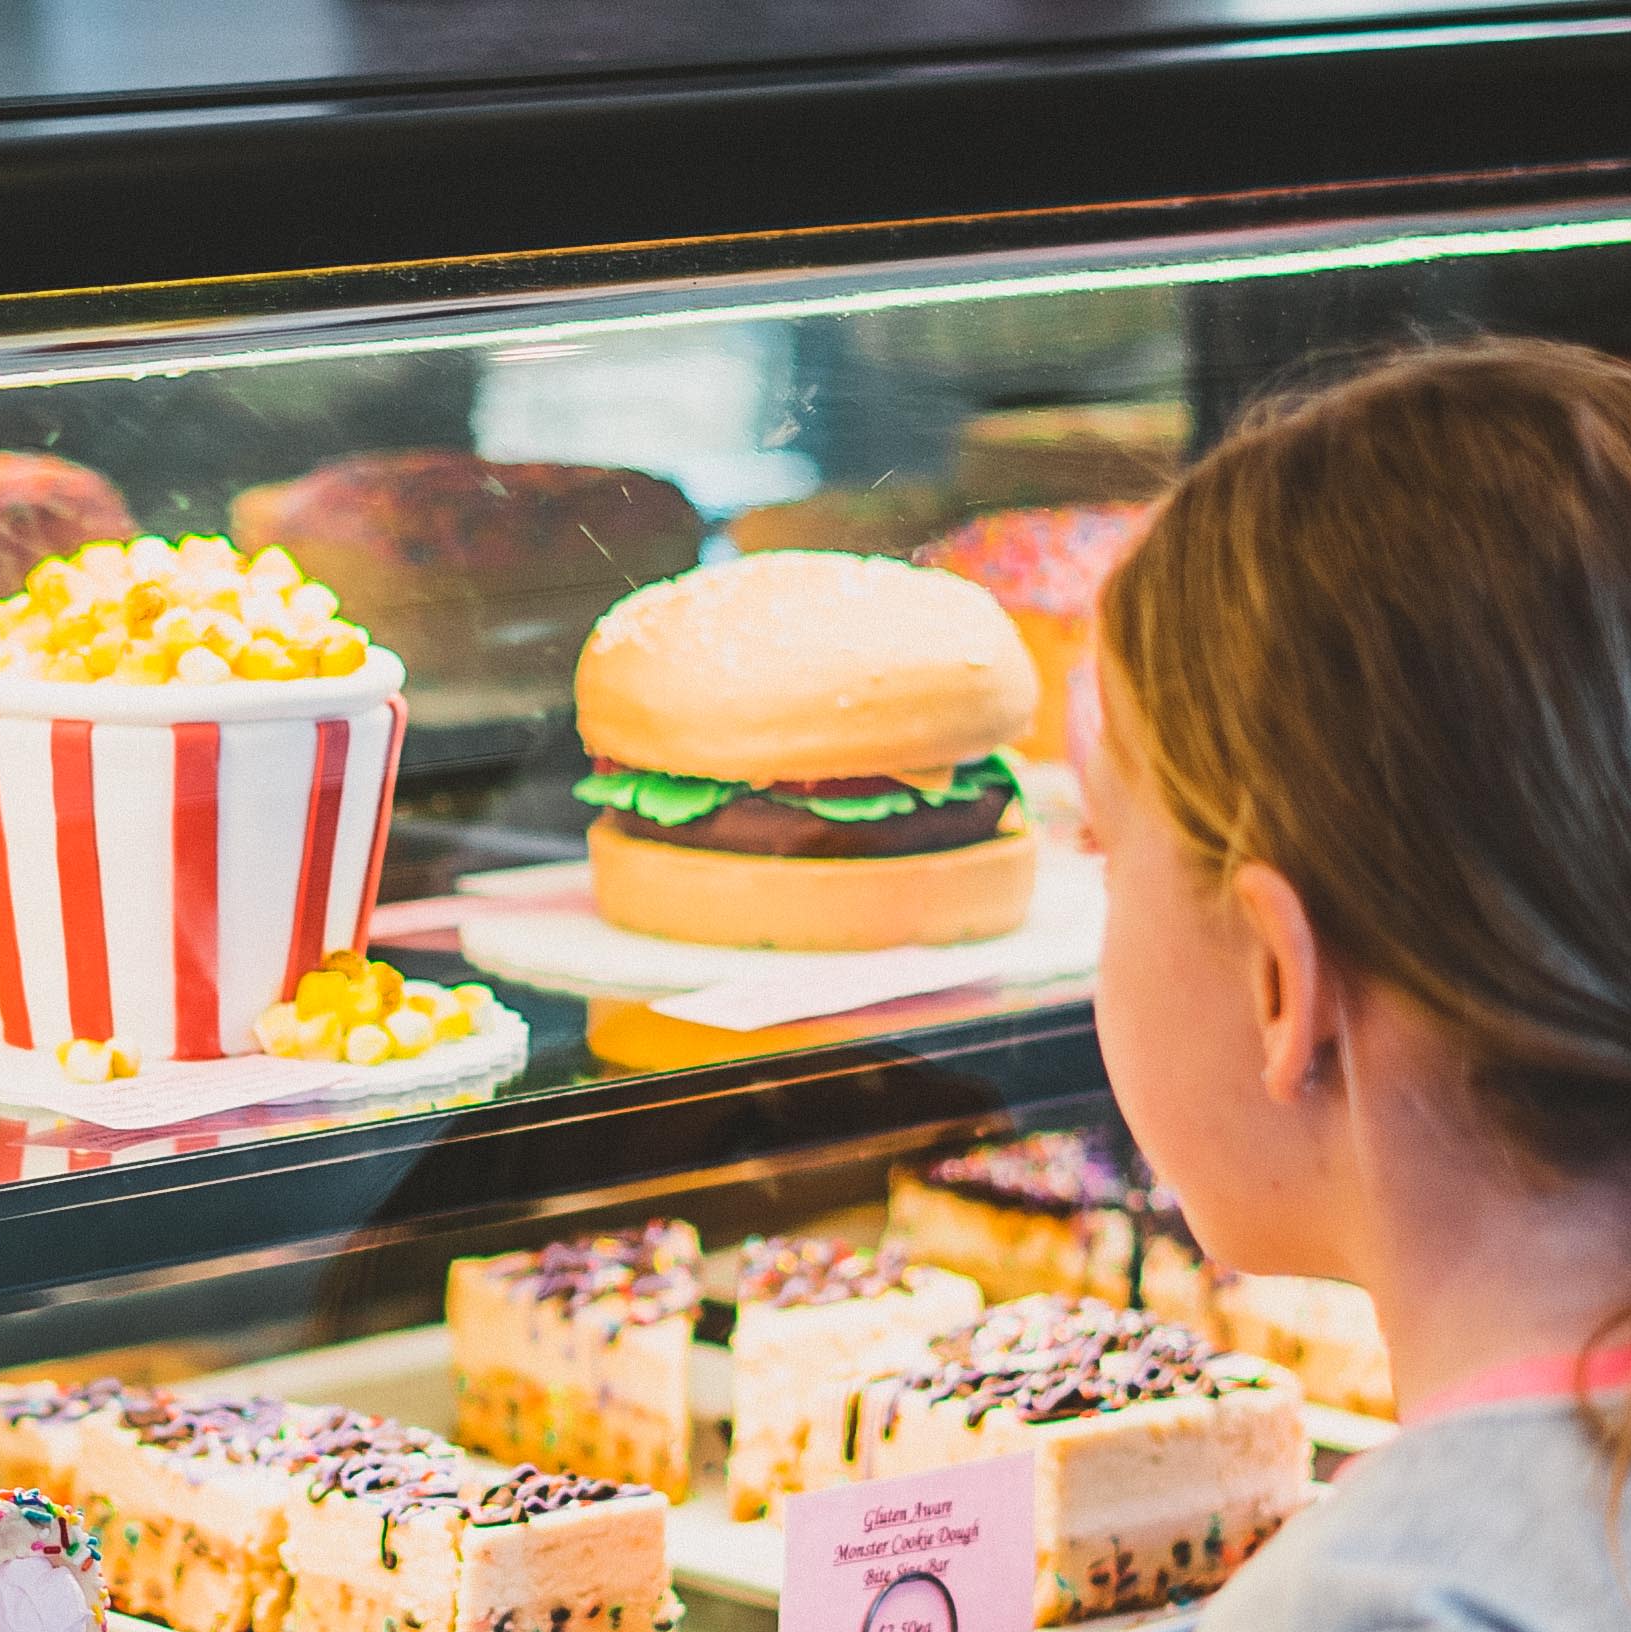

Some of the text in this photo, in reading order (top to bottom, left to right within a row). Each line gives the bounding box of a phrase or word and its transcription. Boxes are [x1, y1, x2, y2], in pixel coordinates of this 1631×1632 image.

[863, 1499, 953, 1533] Gluten Aware
[834, 1520, 980, 1562] Monster Cookie Dough
